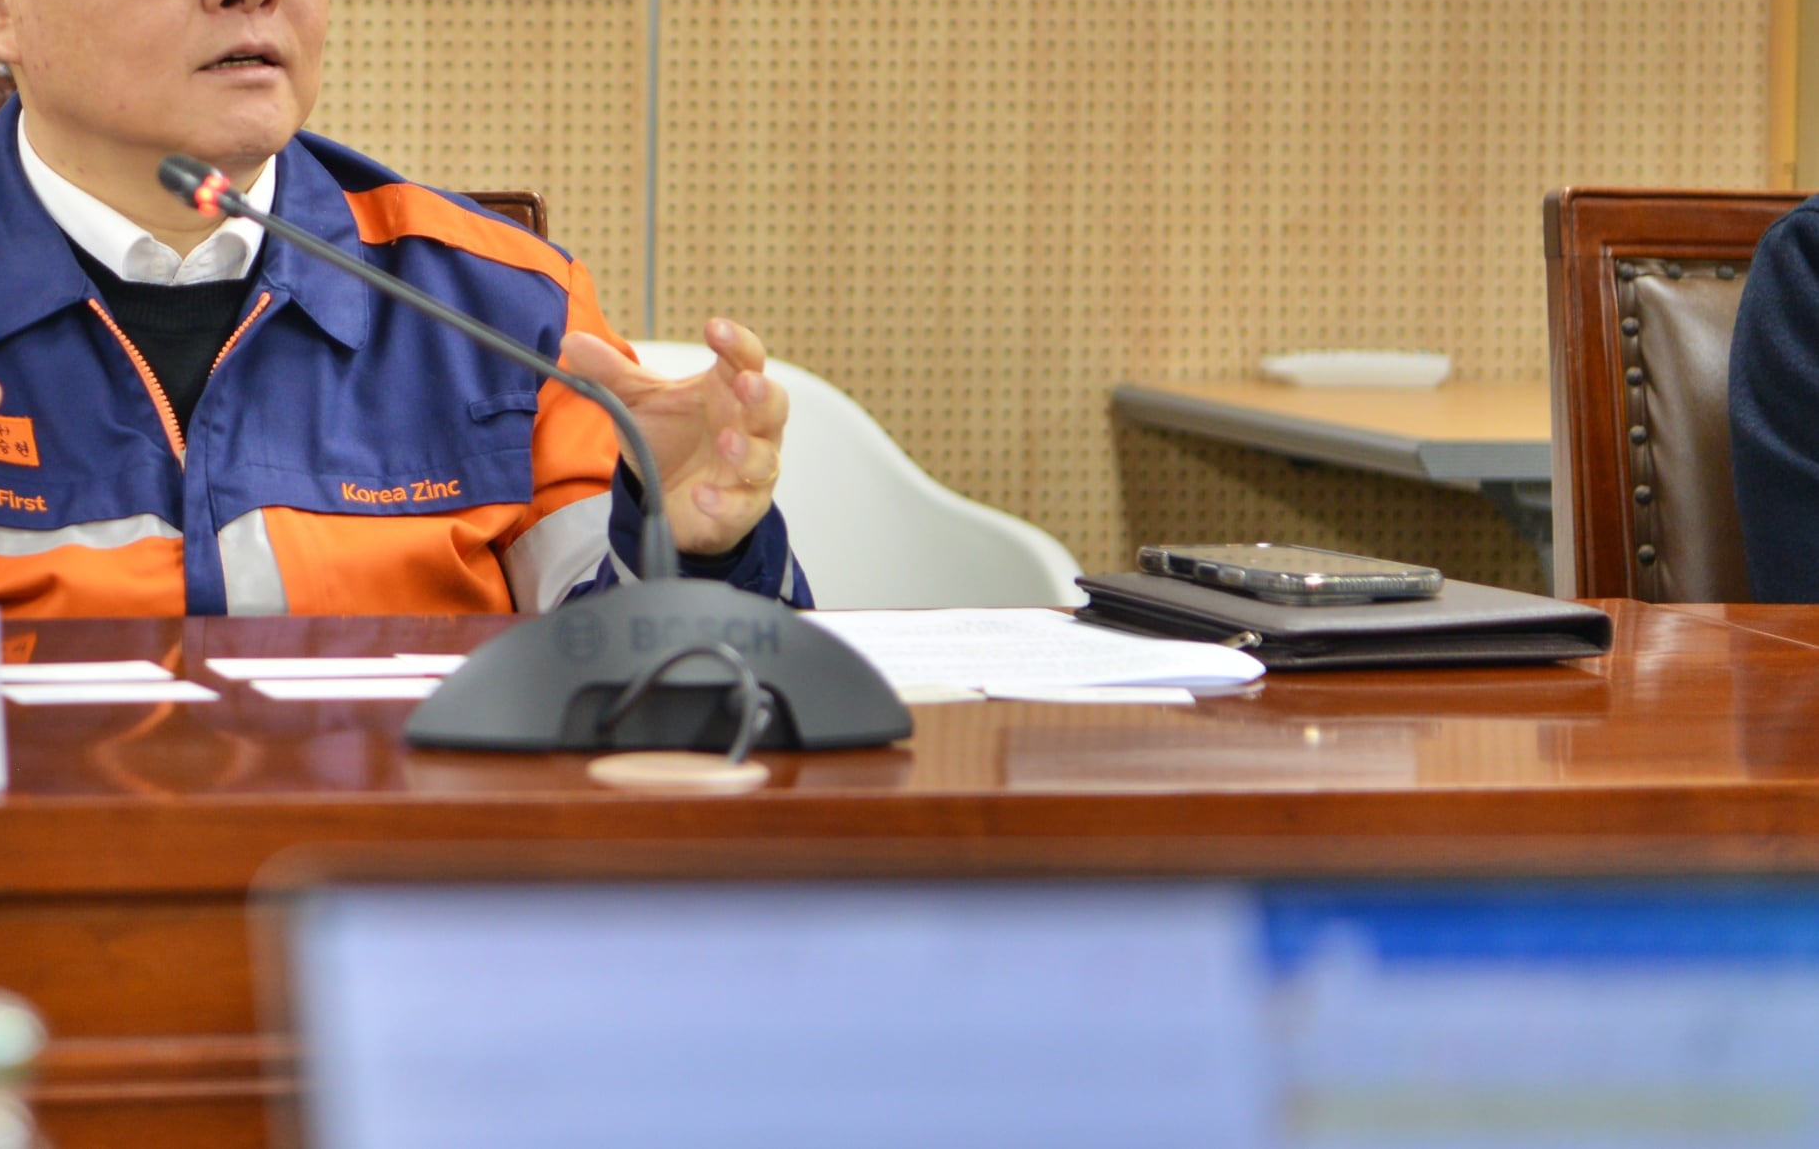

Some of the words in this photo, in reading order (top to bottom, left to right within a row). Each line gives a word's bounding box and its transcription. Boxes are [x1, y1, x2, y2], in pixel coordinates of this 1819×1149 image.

[341, 481, 406, 505] Korea
[412, 478, 460, 501] Zinc
[629, 616, 780, 653] BOSCH
